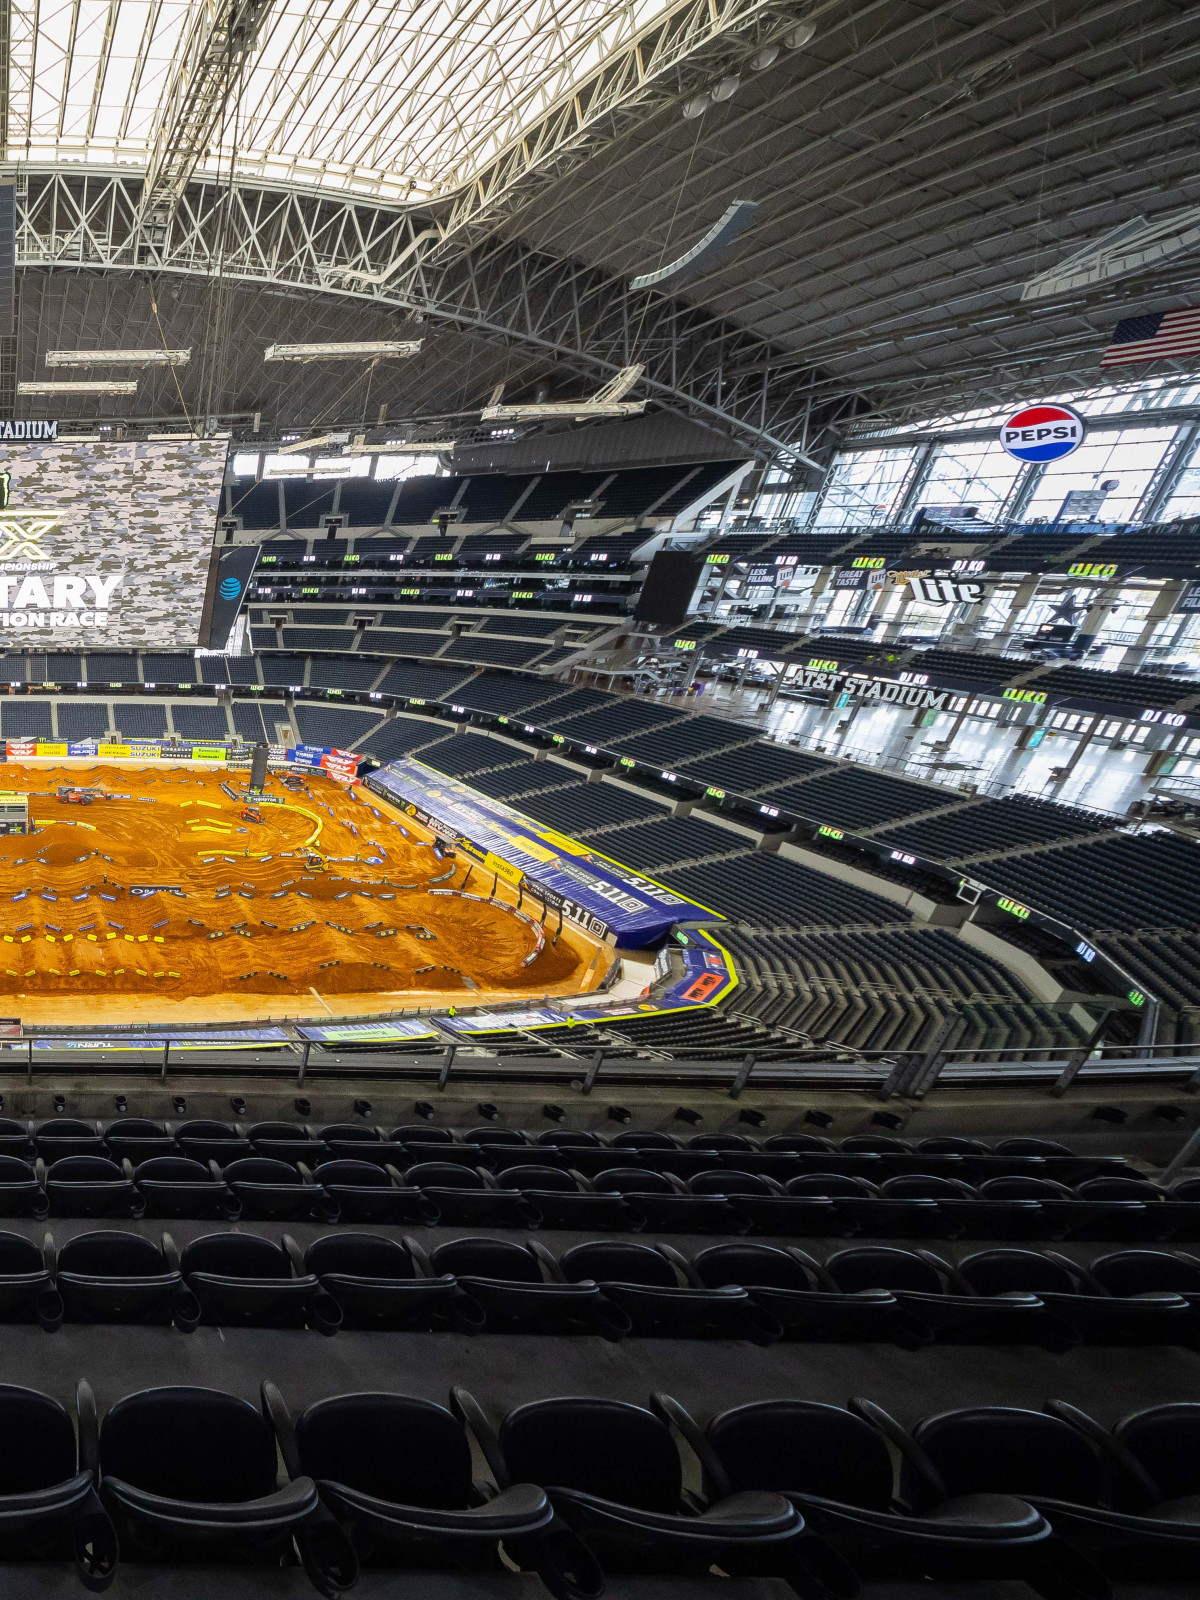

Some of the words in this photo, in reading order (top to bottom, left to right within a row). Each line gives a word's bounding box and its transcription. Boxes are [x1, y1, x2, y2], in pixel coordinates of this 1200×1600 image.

[1005, 426, 1077, 443] PEPSI
[952, 560, 968, 571] DJ
[968, 561, 985, 571] KO
[747, 575, 774, 583] FILLING
[835, 578, 860, 586] TASTE
[839, 570, 864, 578] GREAT
[905, 577, 983, 607] Lite
[49, 612, 108, 628] RACE
[899, 672, 913, 682] DJ
[913, 675, 929, 685] KO
[791, 669, 842, 692] AT&T
[841, 678, 949, 710] STADIUM
[1141, 710, 1158, 724] DJ
[1162, 713, 1186, 726] KO
[588, 880, 623, 903] 5.11
[622, 877, 665, 900] 5.11
[561, 899, 588, 929] 5.11
